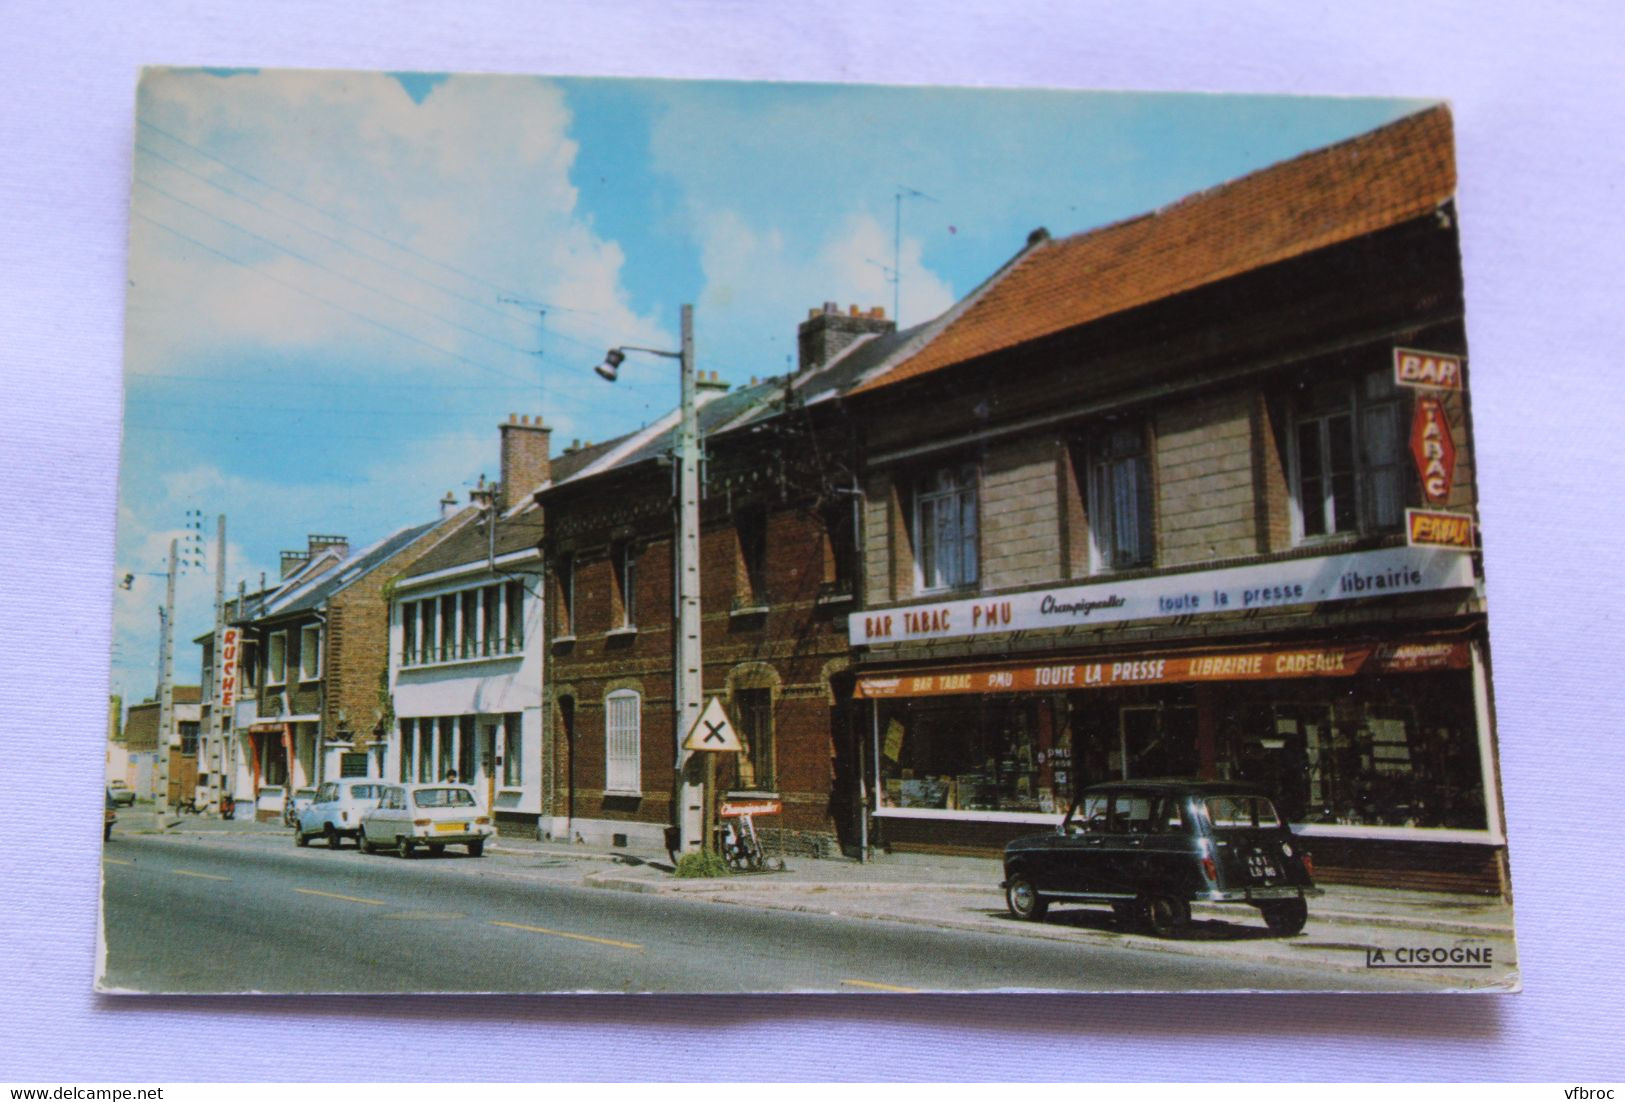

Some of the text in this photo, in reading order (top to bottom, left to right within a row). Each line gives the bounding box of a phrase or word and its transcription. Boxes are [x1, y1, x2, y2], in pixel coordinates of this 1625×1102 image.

[1402, 356, 1457, 386] BAR
[1422, 401, 1446, 497] TABAC
[1412, 515, 1469, 544] PMU
[1159, 566, 1422, 611] toute la presse librairie
[865, 602, 1012, 637] BAR TABAC PMU
[222, 631, 236, 705] RUCHE
[912, 677, 934, 692] BAR
[939, 674, 972, 690] TABAC
[988, 670, 1013, 687] PMU
[1034, 667, 1076, 686] TOUTE
[1084, 663, 1102, 684] LA
[1111, 660, 1165, 681] PRESSE
[1188, 655, 1262, 676] LIBRAIRIE
[1275, 653, 1345, 673] CADEAUX
[1366, 947, 1493, 969] LA CIGOGNE
